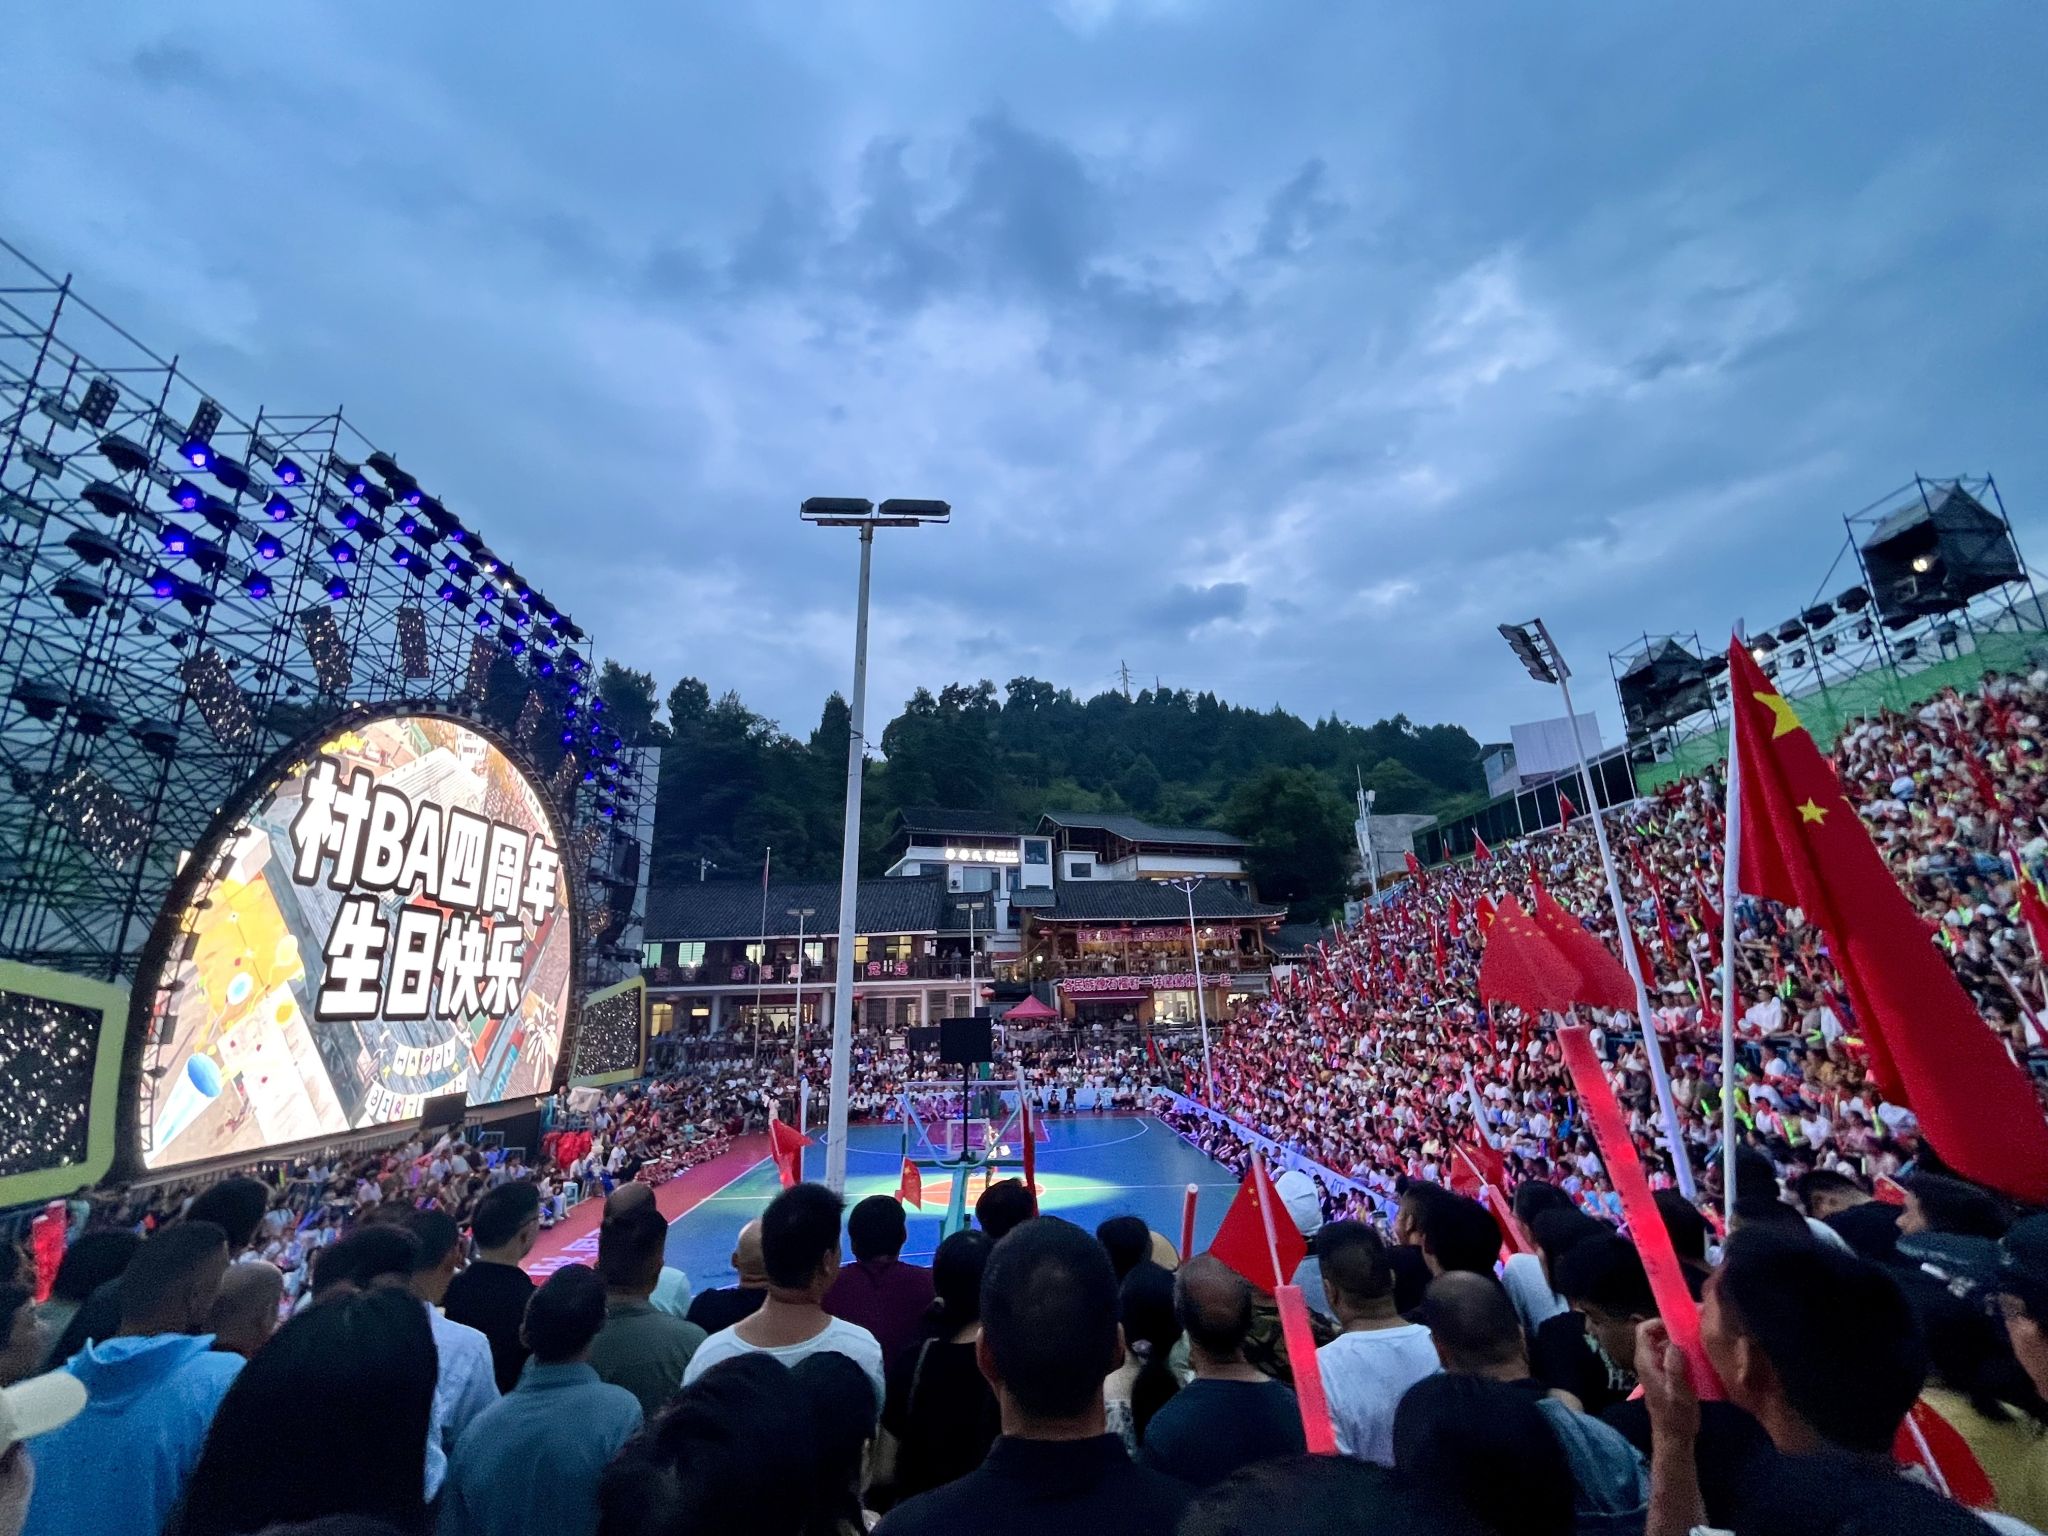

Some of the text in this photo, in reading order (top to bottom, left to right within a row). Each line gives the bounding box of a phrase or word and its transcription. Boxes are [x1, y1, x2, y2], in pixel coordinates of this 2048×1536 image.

[291, 759, 561, 924] 村BA四周年
[316, 895, 524, 1020] 生日快乐
[397, 1048, 451, 1069] HAPPY
